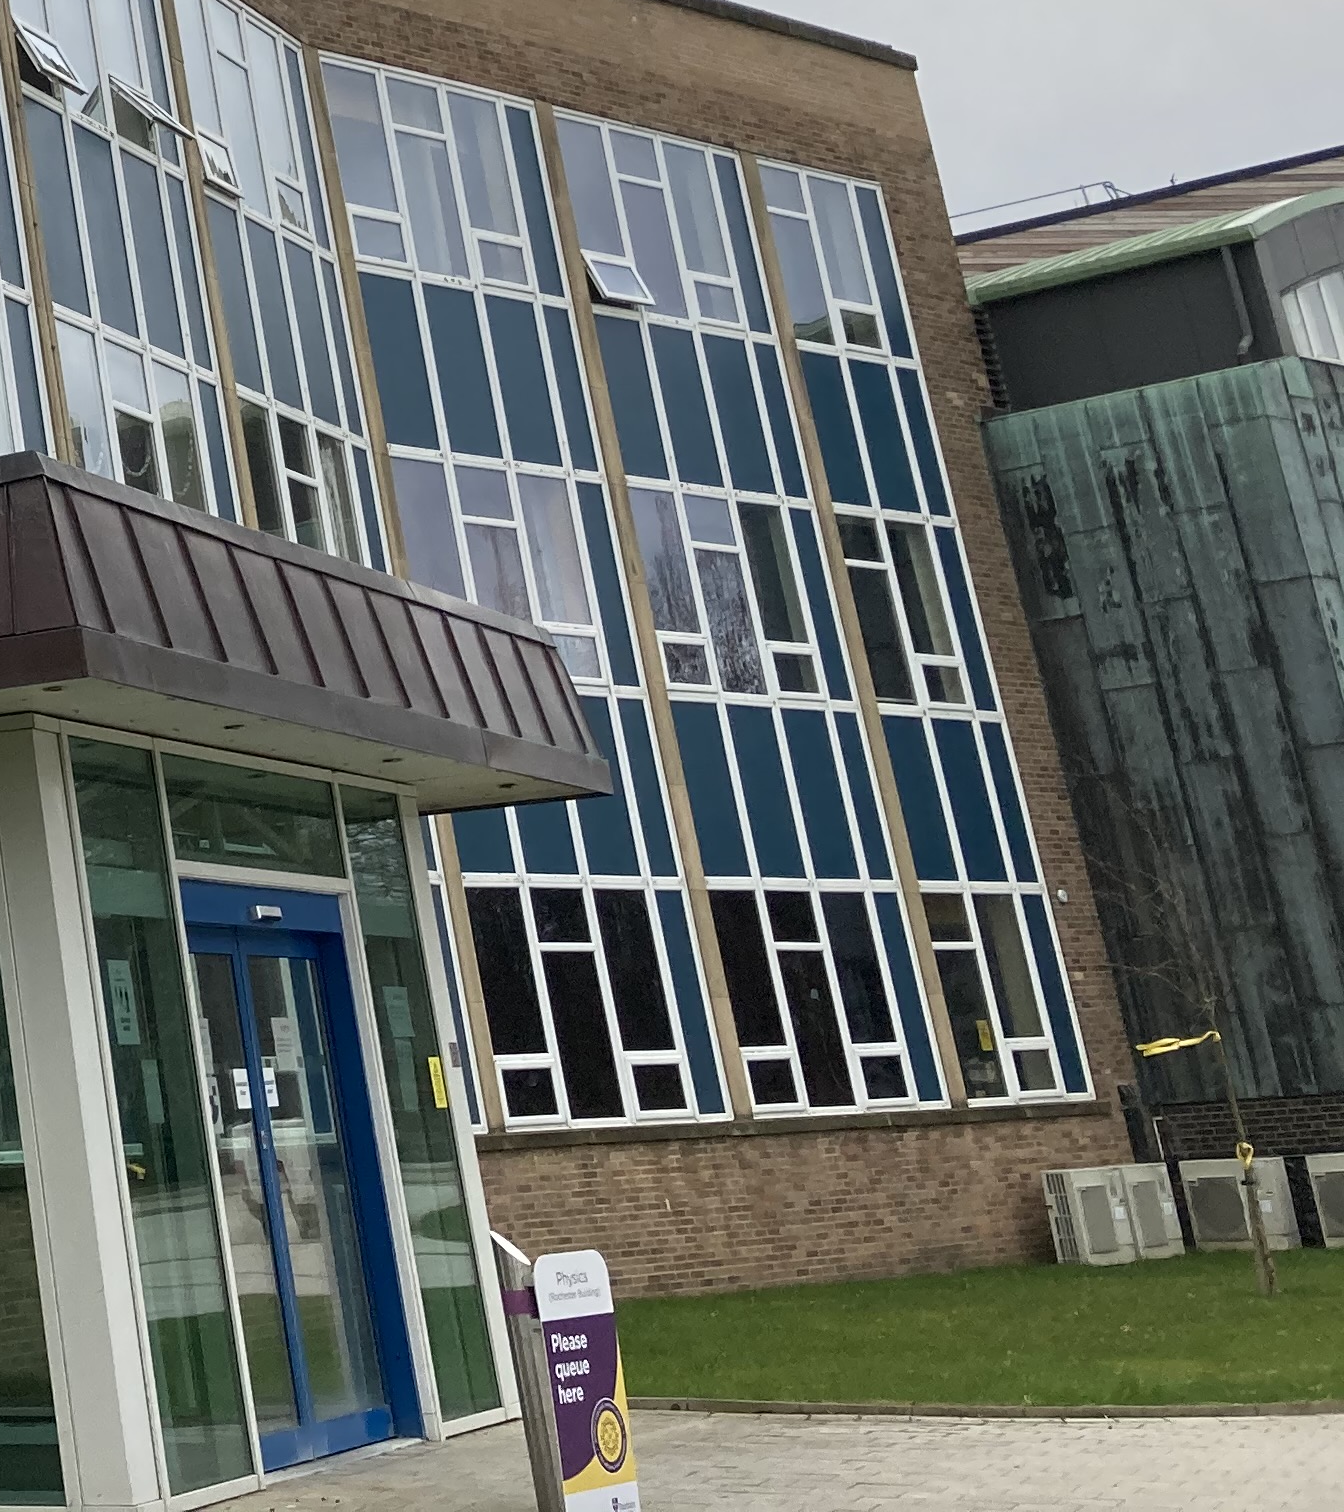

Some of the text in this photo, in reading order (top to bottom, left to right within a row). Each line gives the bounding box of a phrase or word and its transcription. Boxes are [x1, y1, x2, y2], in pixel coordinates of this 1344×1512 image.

[555, 1271, 588, 1288] Physics
[551, 1333, 588, 1354] Please
[555, 1359, 590, 1382] queue
[557, 1384, 584, 1405] here
